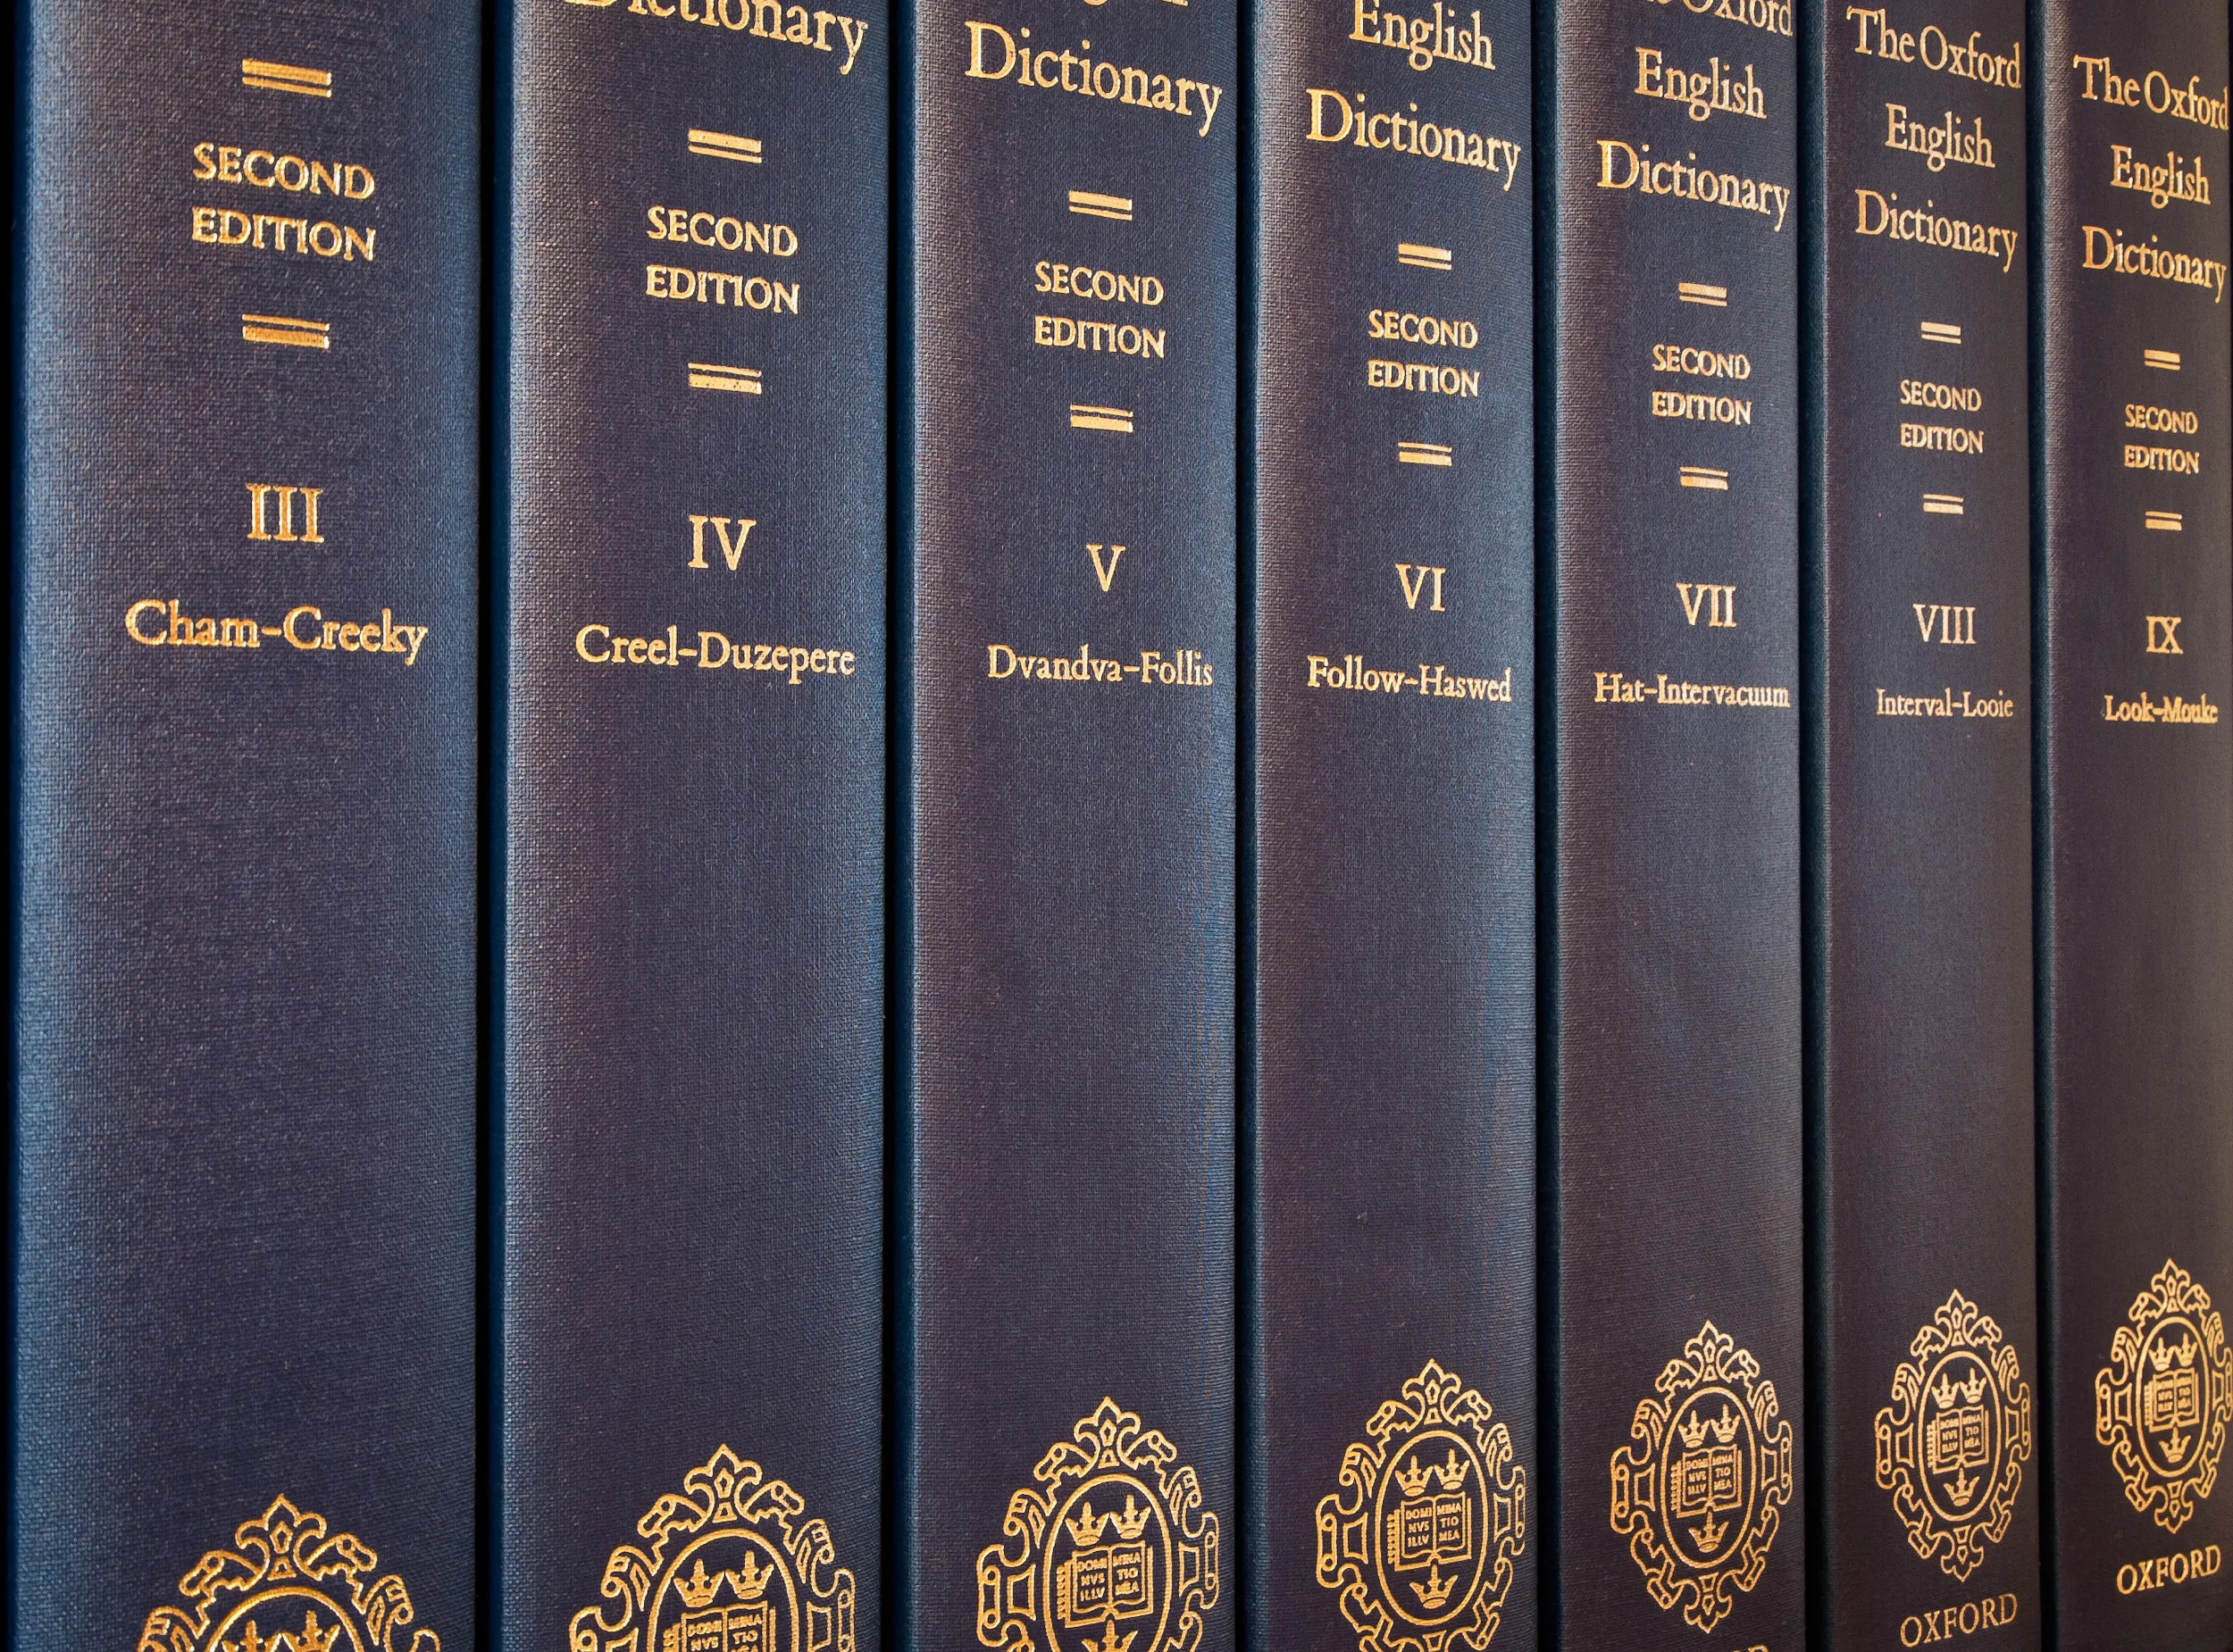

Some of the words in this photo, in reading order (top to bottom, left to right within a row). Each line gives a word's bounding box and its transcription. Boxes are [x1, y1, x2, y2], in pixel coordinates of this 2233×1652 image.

[565, 0, 867, 75] onary
[1350, 0, 1494, 71] English
[1683, 0, 1793, 36] xord
[1846, 5, 1915, 63] The
[1920, 26, 2021, 88] Oxford
[965, 21, 1221, 138] Dictionary
[1635, 47, 1766, 121] English
[2073, 54, 2140, 106] The
[2145, 71, 2229, 130] Oxford
[1306, 88, 1519, 191] Dictionary
[1886, 103, 1995, 171] English
[192, 142, 376, 201] SECOND
[1596, 139, 1789, 230] Dictionary
[2111, 144, 2212, 208] English
[191, 206, 375, 261] EDITION
[648, 205, 797, 256] SECOND
[1855, 188, 2018, 272] Dictionary
[1036, 261, 1164, 305] SECOND
[2082, 226, 2227, 304] Dictionary
[647, 264, 799, 313] EDITION
[1035, 315, 1165, 357] EDITION
[1369, 309, 1477, 348] SECOND
[1368, 359, 1478, 395] EDITION
[1653, 344, 1750, 379] SECOND
[1652, 391, 1751, 422] EDITION
[1901, 380, 1982, 412] SECOND
[1901, 423, 1984, 454] EDITION
[2125, 404, 2198, 434] SECOND
[2124, 445, 2200, 474] EDITION
[246, 483, 322, 543] III
[689, 515, 757, 571] IV
[1086, 544, 1125, 592] V
[1396, 564, 1444, 611] VI
[1677, 583, 1735, 627] VII
[1913, 605, 1976, 645] VIII
[125, 599, 427, 665] Cham-Creeky
[575, 624, 854, 684] Creel-Duzepere
[2145, 615, 2184, 655] IX
[988, 644, 1212, 686] Dvandva-Follis
[1308, 655, 1511, 702] Follow-Haswed
[1594, 672, 1789, 706] Hat-Intervacuum
[1878, 688, 2013, 717] Interval-Looie
[1715, 1466, 1731, 1478] TIO
[1405, 1507, 1432, 1520] DOMI
[1409, 1522, 1429, 1533] NVS
[1440, 1516, 1459, 1528] TIO
[1408, 1534, 1429, 1548] ILLV
[1438, 1530, 1459, 1542] MEA
[1081, 1573, 1105, 1586] NVS
[1116, 1567, 1139, 1580] TIO
[2117, 1545, 2220, 1594] OXFORD
[1080, 1588, 1105, 1601] ILLV
[732, 1630, 758, 1644] TIO
[1901, 1594, 2017, 1647] OXFORD
